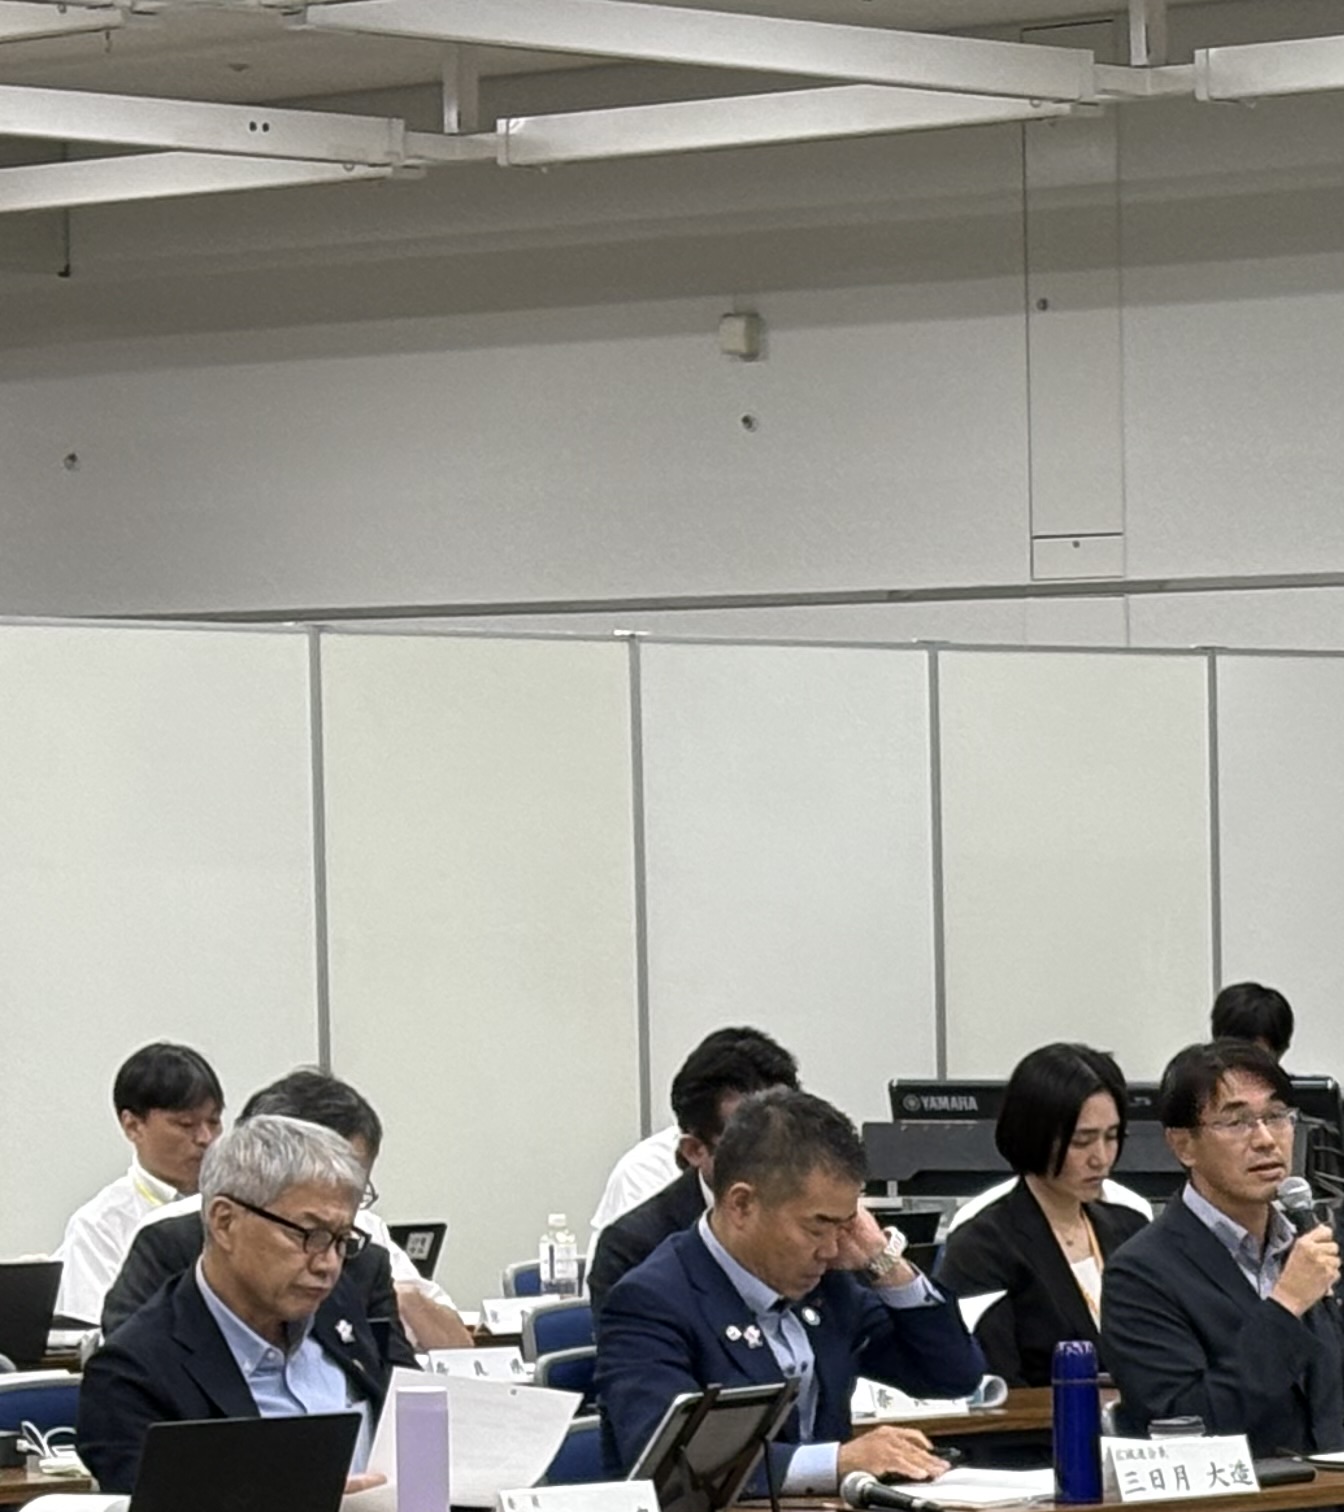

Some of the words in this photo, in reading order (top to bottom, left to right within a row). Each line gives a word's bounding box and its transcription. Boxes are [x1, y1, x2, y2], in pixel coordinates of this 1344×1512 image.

[921, 1096, 978, 1112] YAMAHA
[1124, 1464, 1191, 1494] 三日月
[1206, 1459, 1254, 1488] 大造
